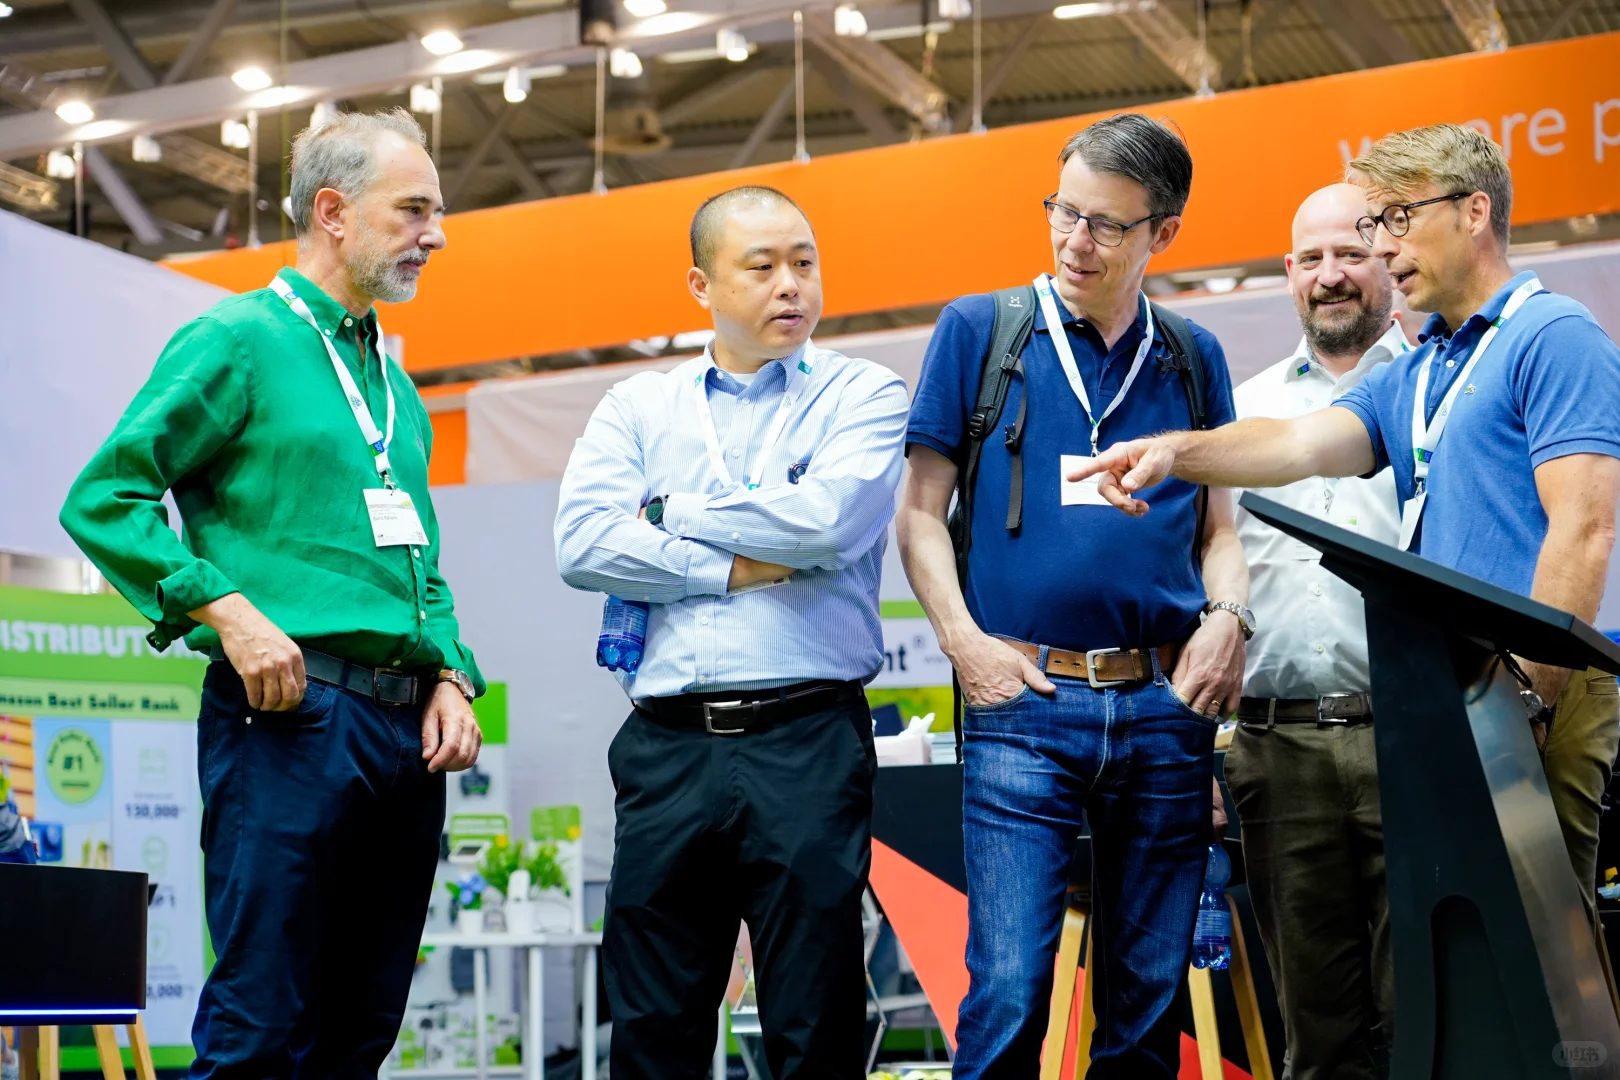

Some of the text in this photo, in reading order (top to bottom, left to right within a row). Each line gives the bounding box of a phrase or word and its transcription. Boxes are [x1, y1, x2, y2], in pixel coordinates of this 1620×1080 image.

[48, 691, 81, 709] Best
[89, 694, 133, 710] Seller
[141, 697, 179, 711] Rank
